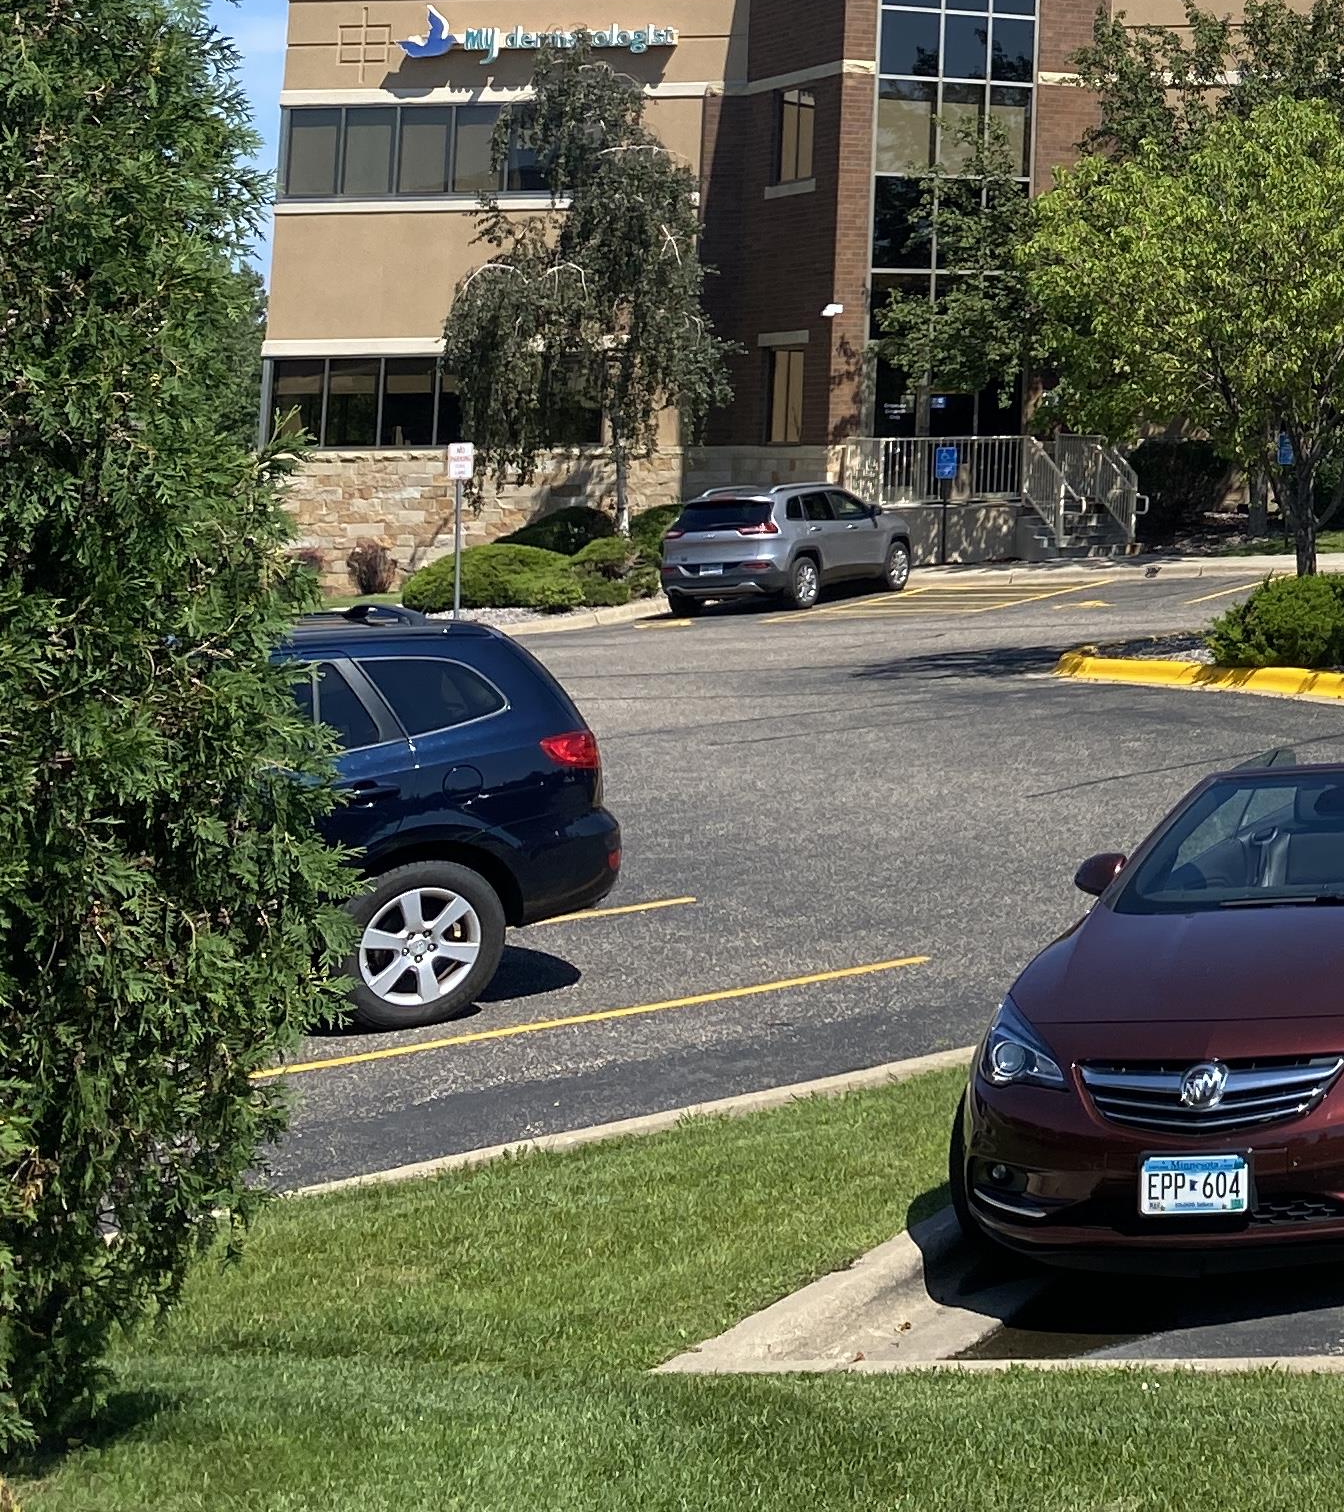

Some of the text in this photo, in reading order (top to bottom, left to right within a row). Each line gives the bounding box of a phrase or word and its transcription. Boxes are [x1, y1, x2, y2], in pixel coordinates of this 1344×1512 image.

[1170, 1159, 1219, 1170] Minnesota
[1147, 1171, 1241, 1201] EPP 604
